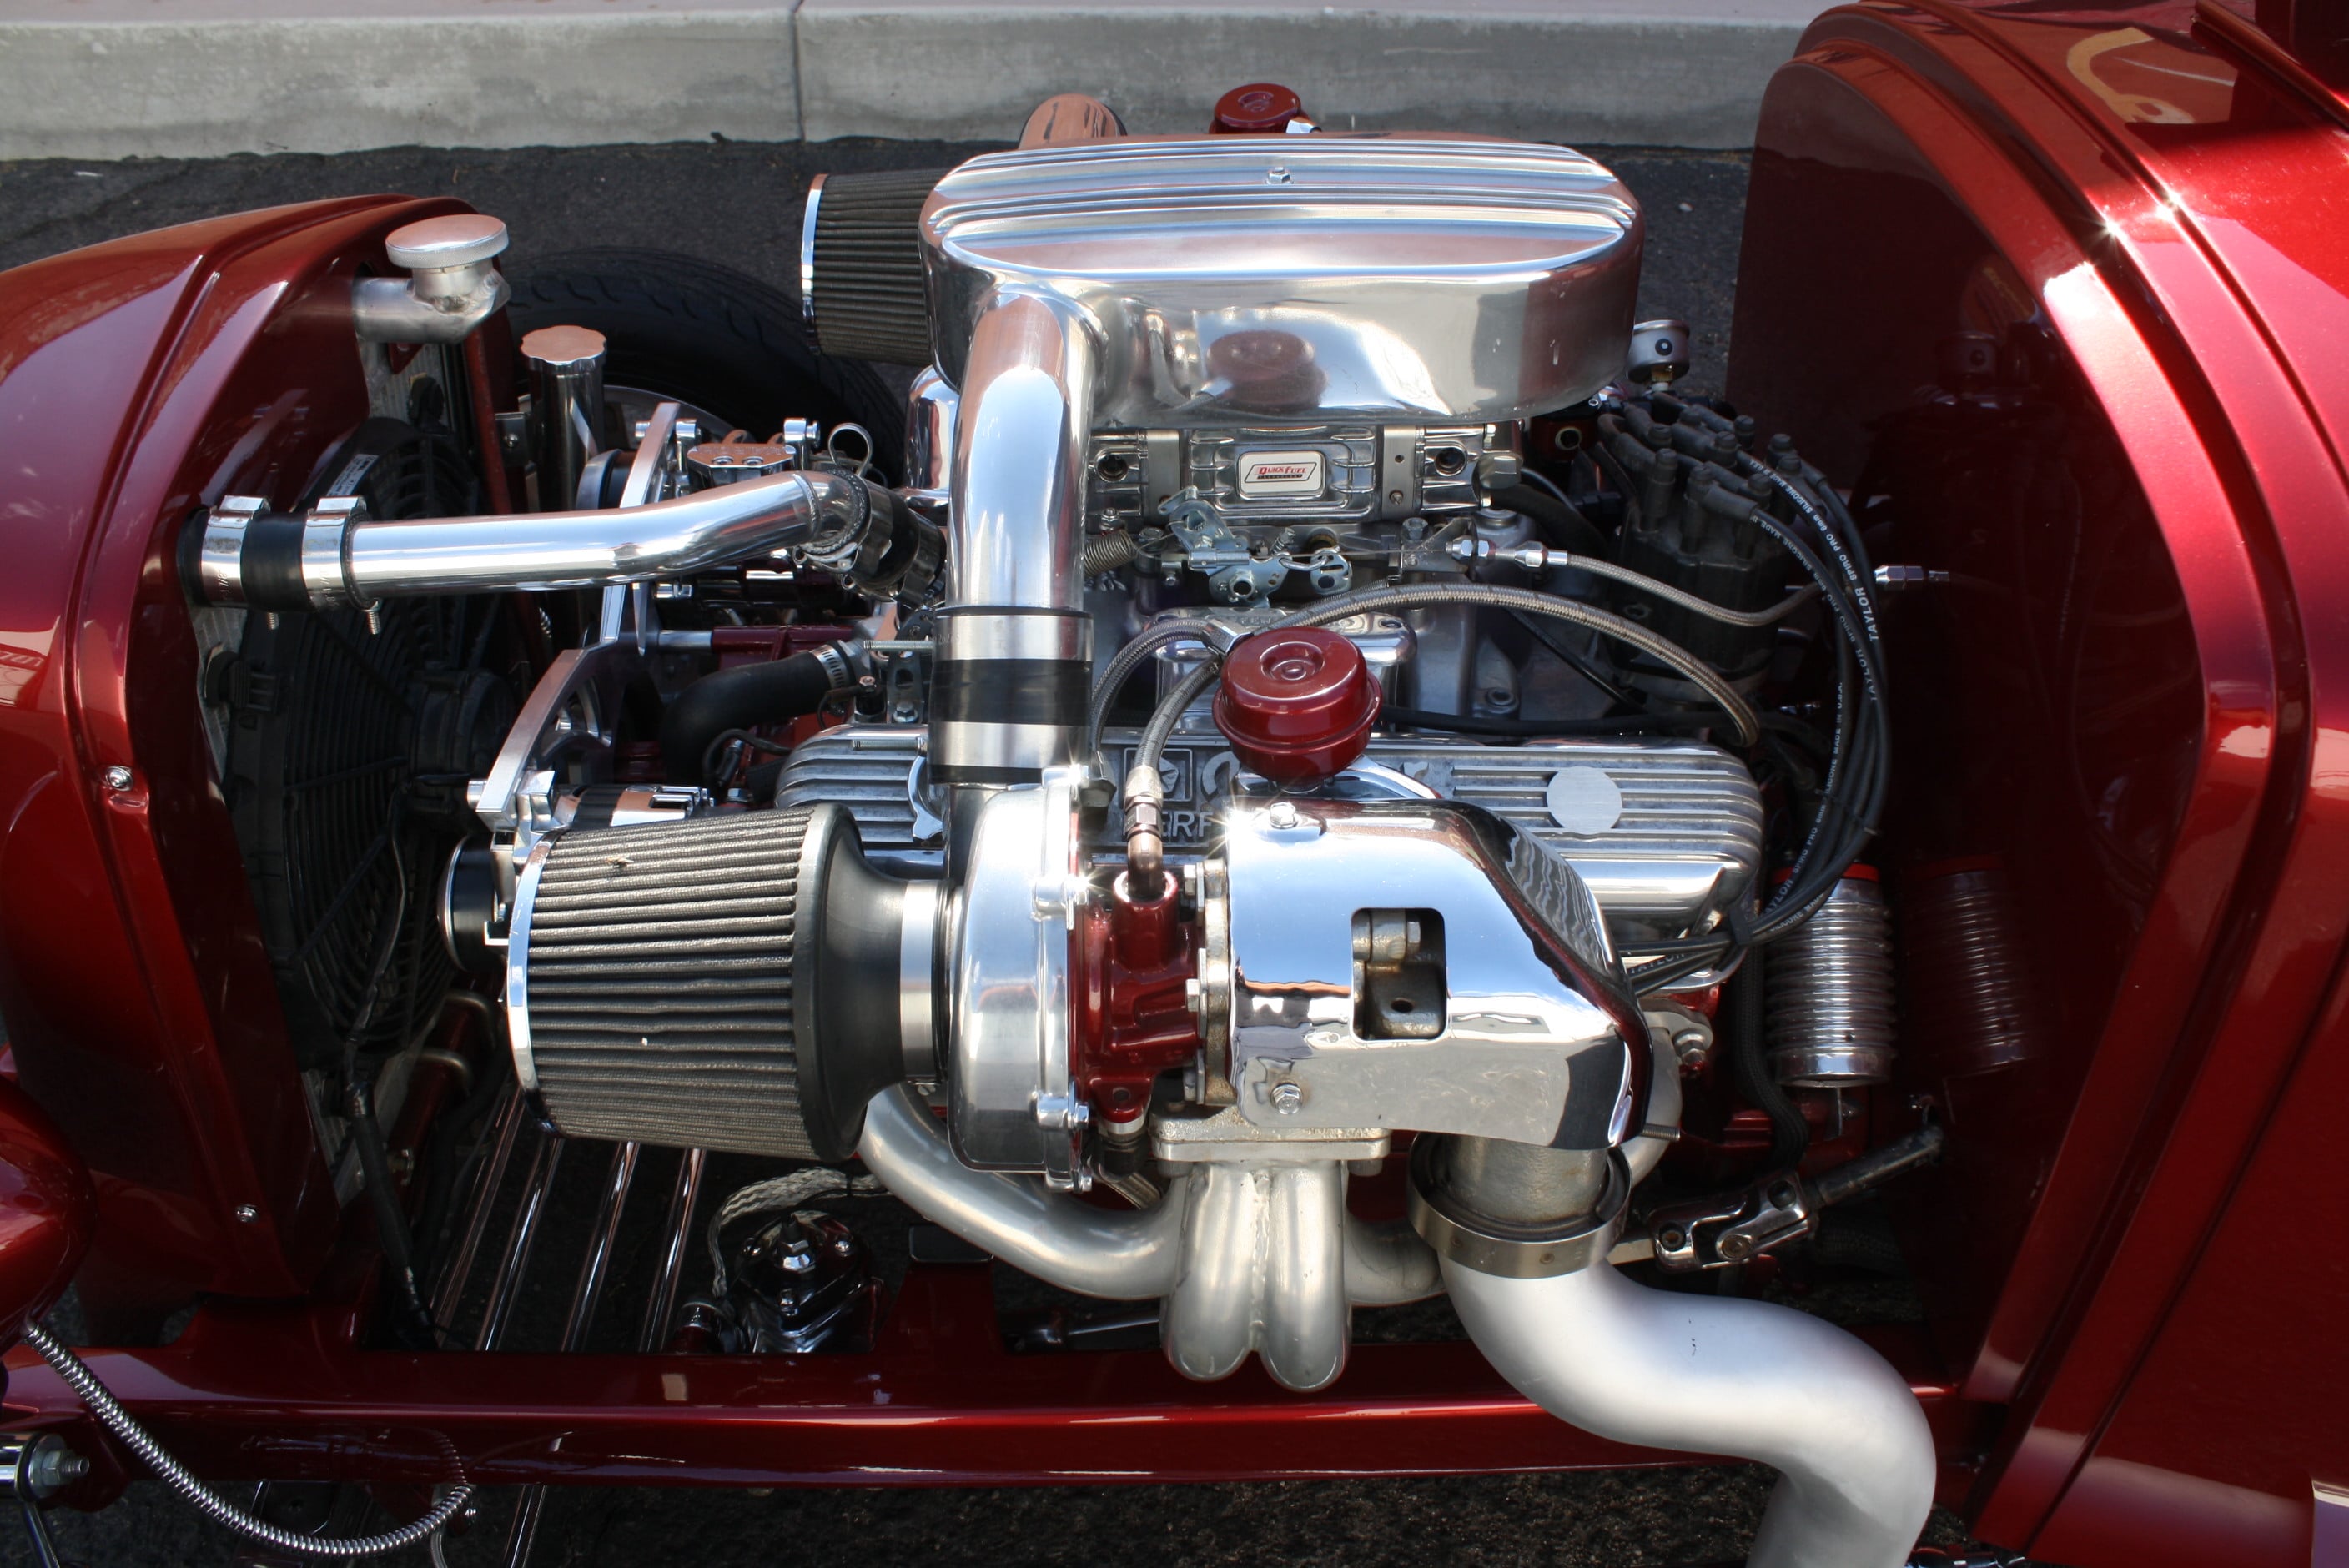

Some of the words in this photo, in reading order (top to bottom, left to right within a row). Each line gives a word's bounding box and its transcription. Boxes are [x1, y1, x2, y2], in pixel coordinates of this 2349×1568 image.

[1785, 486, 1813, 514] SILICONE
[1759, 520, 1782, 540] MADE
[1825, 533, 1842, 552] PRO
[1782, 537, 1813, 572] SILICONE
[1838, 553, 1858, 581] SPIRO
[1854, 586, 1879, 641] TAYLOR
[1855, 648, 1877, 701] TAYLOR
[1765, 878, 1794, 913] AYLOR
